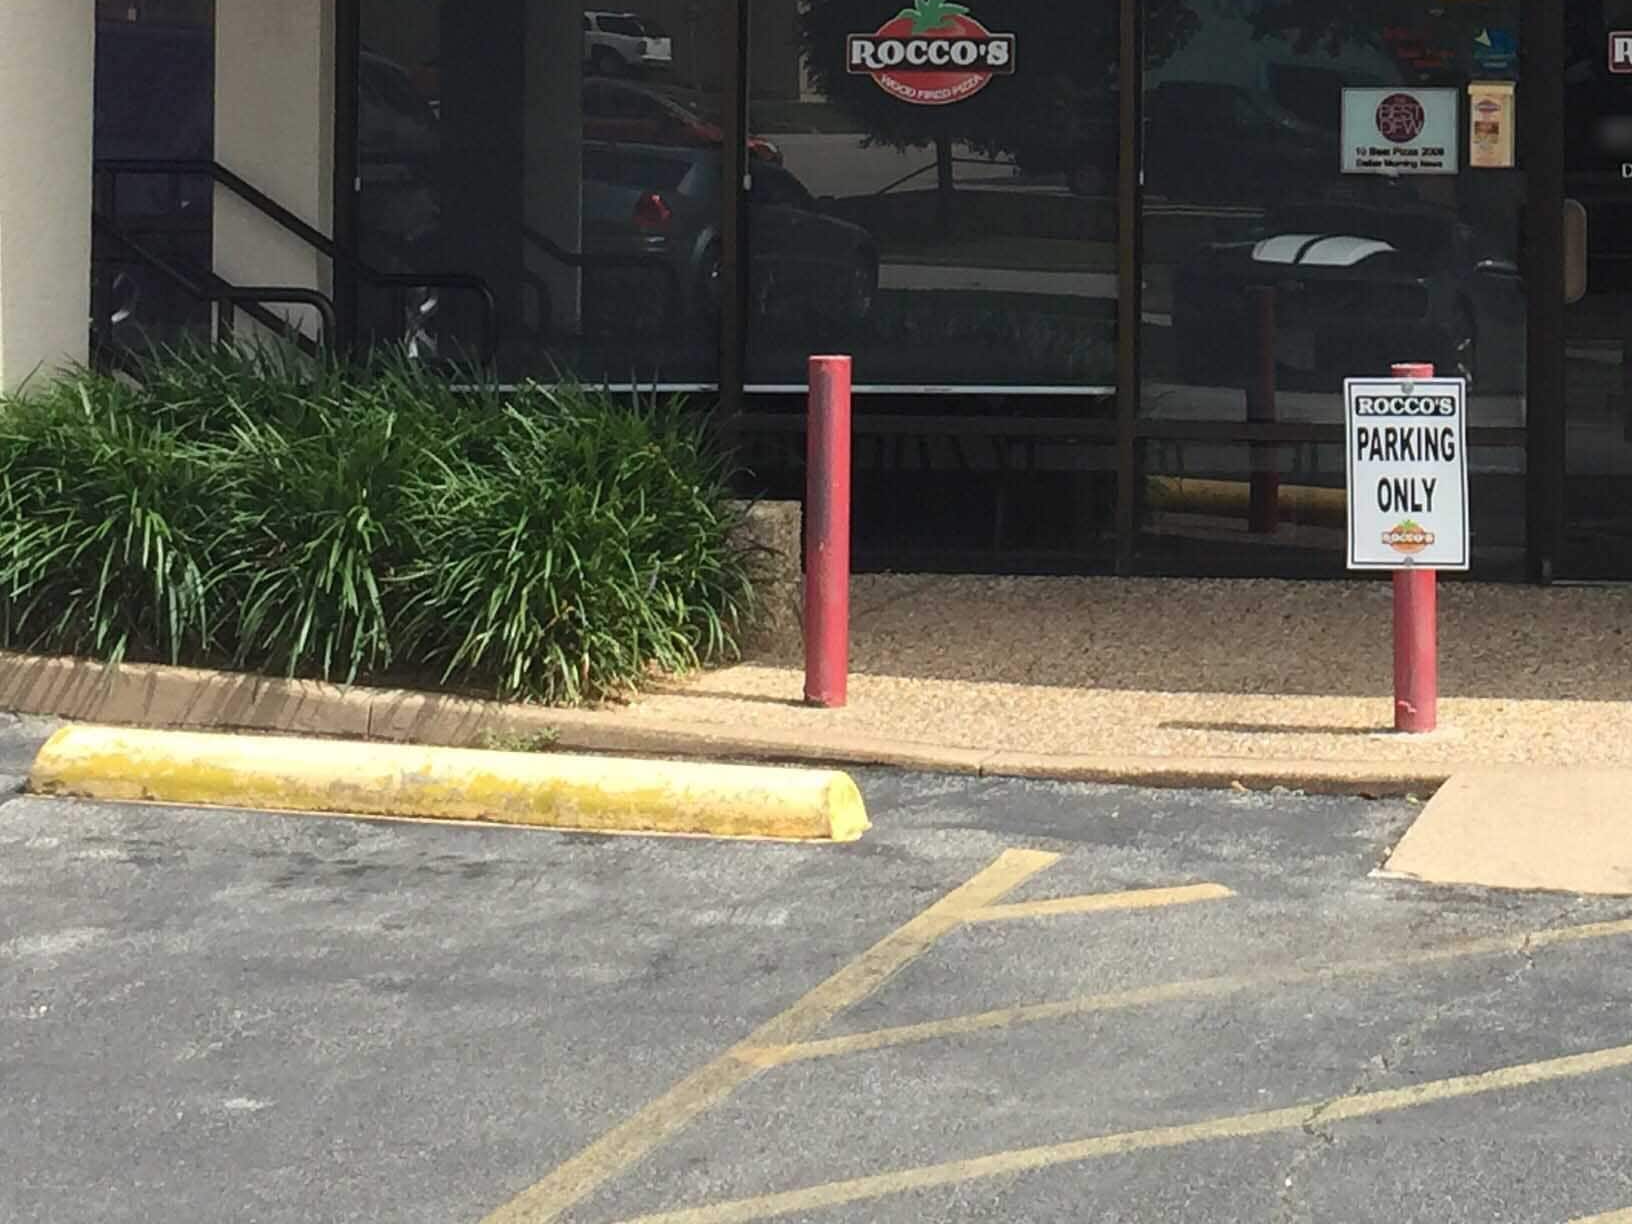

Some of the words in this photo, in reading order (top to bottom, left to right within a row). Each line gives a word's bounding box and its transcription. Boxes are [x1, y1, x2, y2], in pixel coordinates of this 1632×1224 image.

[851, 40, 1009, 69] ROCCO'S
[881, 73, 917, 99] WOOD
[917, 88, 951, 101] FIRED
[1358, 398, 1453, 415] ROCCO'S
[1357, 427, 1455, 462] PARKING
[1377, 477, 1437, 513] ONLY
[1383, 533, 1434, 544] ROCCO'S
